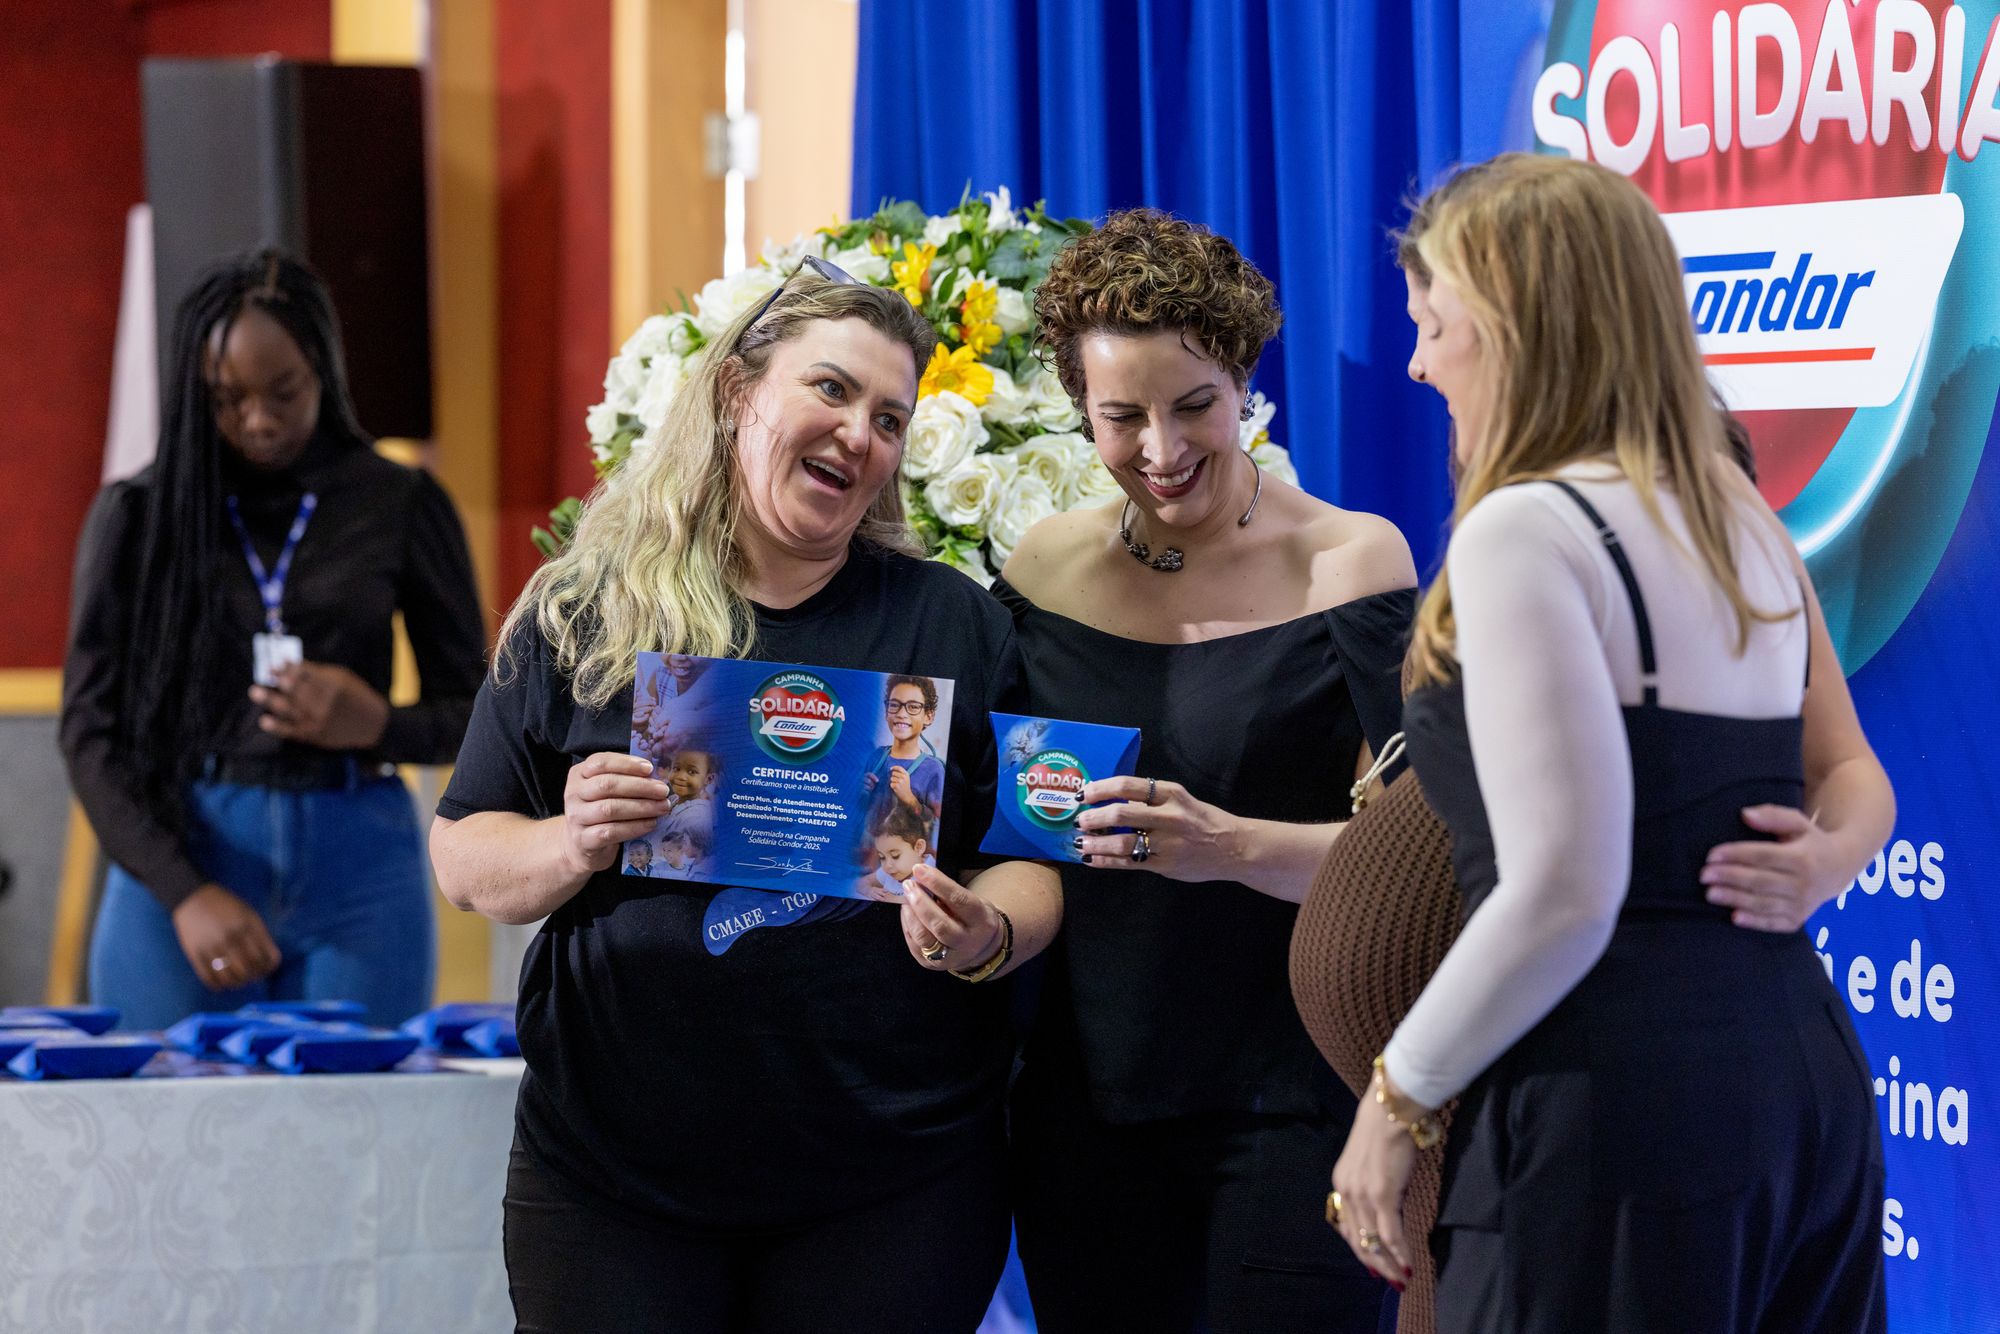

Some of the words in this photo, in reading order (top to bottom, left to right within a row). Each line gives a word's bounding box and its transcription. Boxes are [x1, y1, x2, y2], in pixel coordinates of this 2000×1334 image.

[775, 673, 824, 690] CAMPANHA
[749, 697, 845, 721] SOLIDÁRIA
[773, 720, 816, 732] Condor
[1038, 752, 1078, 767] CAMPANHA
[752, 766, 829, 783] CERTIFICADO
[1016, 772, 1092, 789] SOLIDÁRI
[741, 778, 782, 788] Certificamos
[803, 784, 839, 794] instituição:
[732, 793, 755, 801] Centro
[782, 798, 826, 809] Atendimento
[826, 803, 844, 811] Educ.
[1036, 792, 1071, 803] Condor
[727, 801, 772, 812] Especializado
[773, 806, 812, 816] Transtornos
[813, 810, 837, 819] Globais
[736, 811, 793, 823] Desenvolvimento
[797, 817, 837, 827] CMAEE/TGD
[741, 827, 752, 835] Foi
[752, 829, 784, 839] premiada
[794, 833, 830, 843] Campanha
[748, 836, 777, 846] Solidária
[777, 840, 802, 849] Condor
[803, 842, 821, 851] 2025.
[708, 908, 765, 941] CMAEE
[1848, 955, 1877, 1014] e
[1890, 938, 1955, 1022] de
